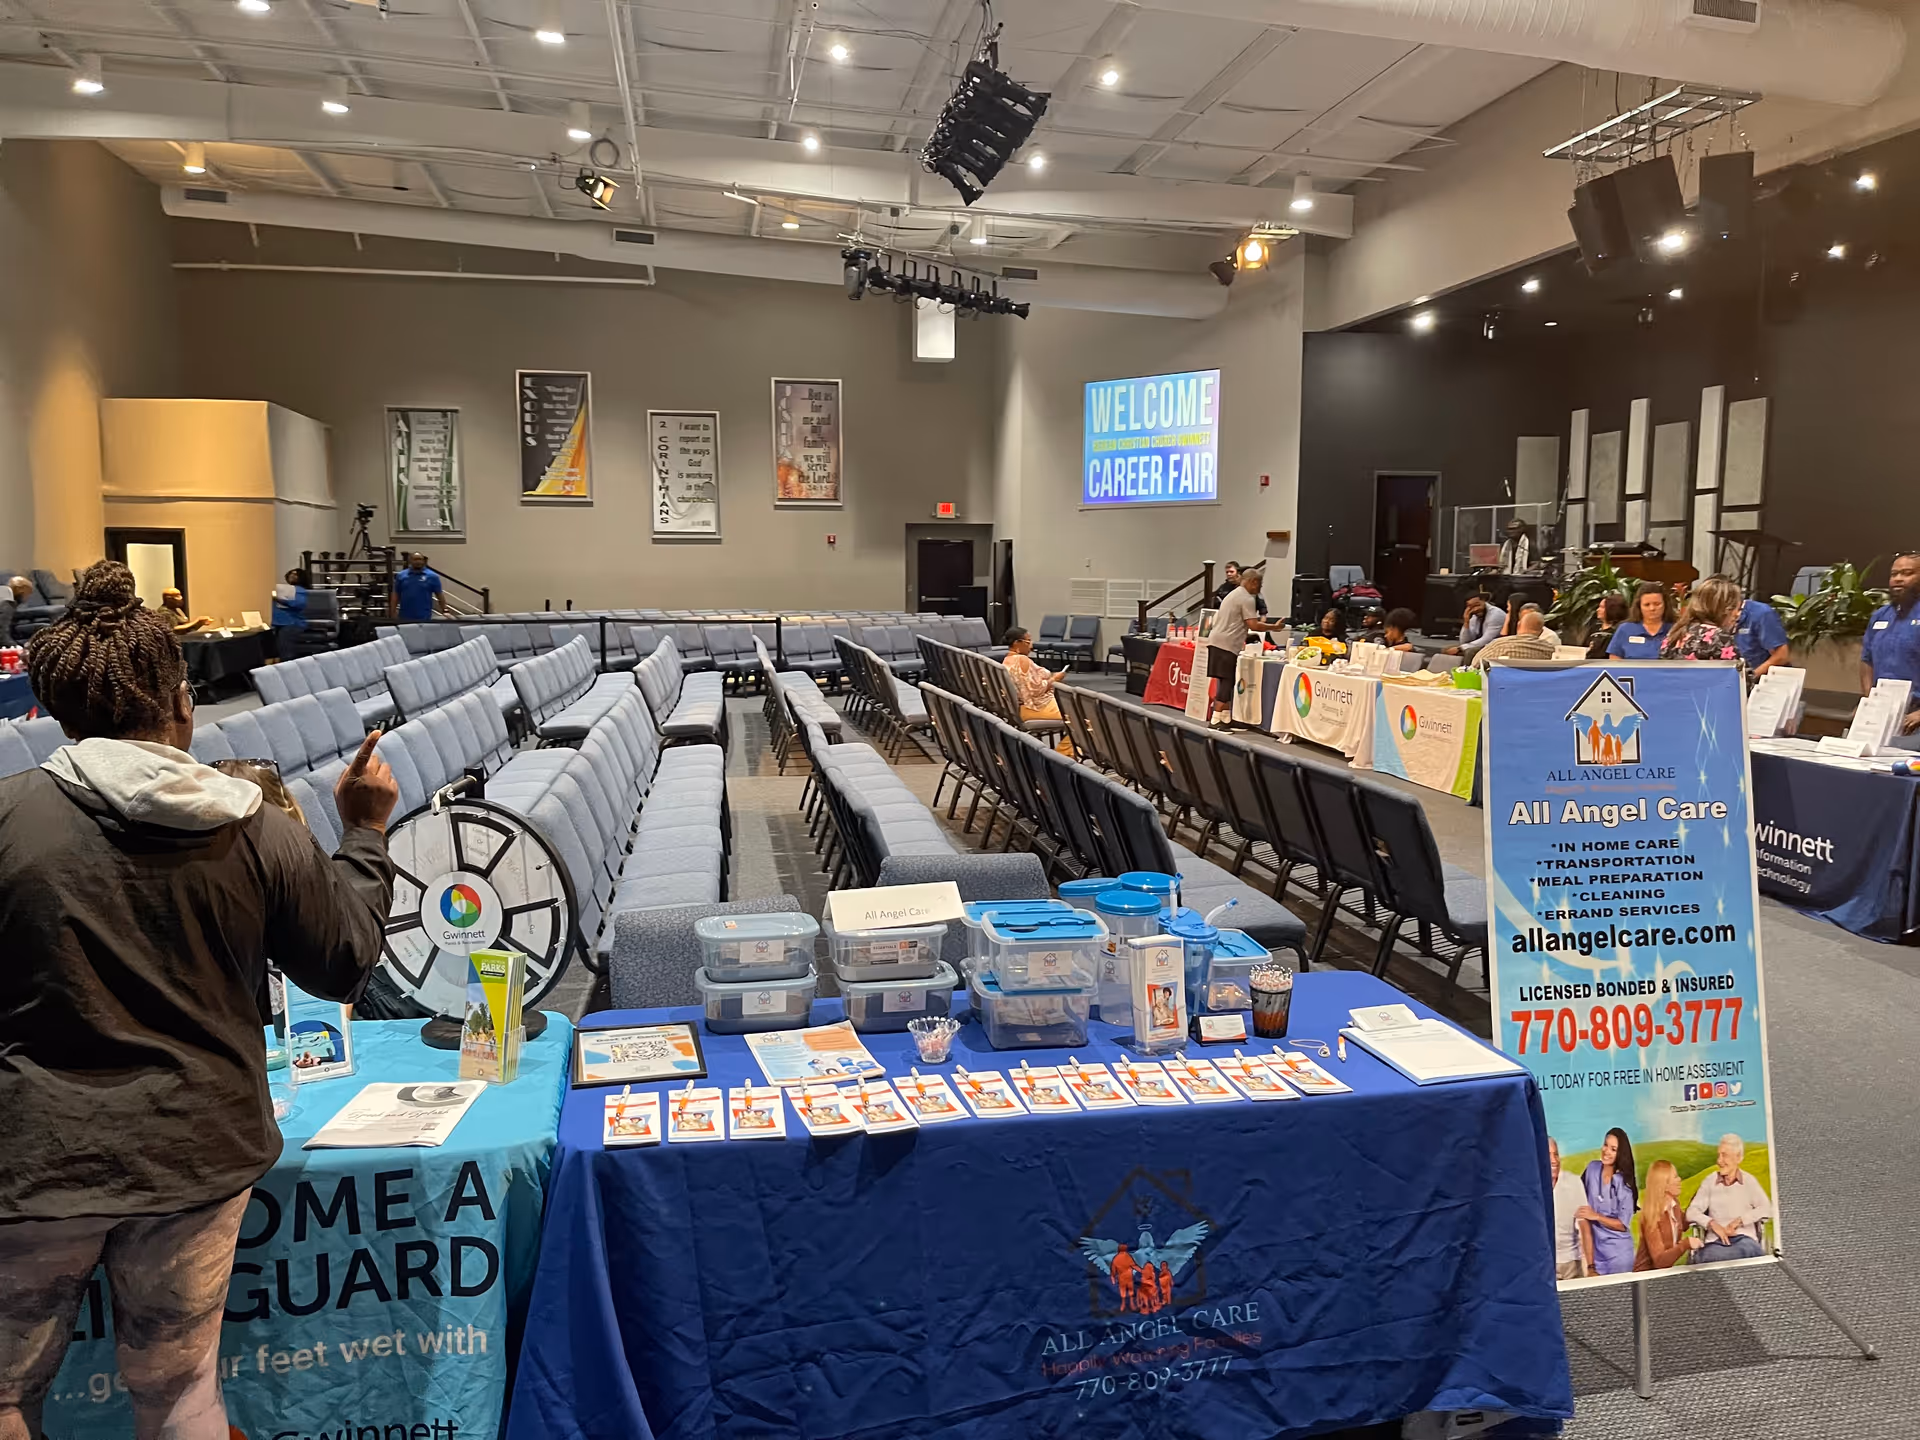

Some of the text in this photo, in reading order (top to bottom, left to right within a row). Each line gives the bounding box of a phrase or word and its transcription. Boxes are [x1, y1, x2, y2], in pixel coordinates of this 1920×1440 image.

[1091, 376, 1214, 433] WELCOME
[688, 458, 702, 468] God
[692, 448, 711, 457] ways
[657, 436, 670, 524] CORINTHIANS
[807, 463, 828, 472] serve
[1088, 452, 1214, 498] CAREER FAIR
[1314, 681, 1353, 706] Gwinnett
[1418, 715, 1453, 735] Gwinnett
[1546, 766, 1676, 783] ALL ANGEL CARE
[1508, 796, 1728, 828] All Angel Care
[1581, 840, 1630, 852] HOME
[1634, 838, 1680, 850] CARE
[1754, 820, 1834, 864] winnett
[1756, 848, 1812, 875] nformation
[1588, 870, 1704, 886] PREPARATION
[1757, 866, 1812, 894] echnology
[864, 907, 931, 920] All Angel Care
[1618, 903, 1701, 918] SERVICES
[442, 930, 486, 940] Gwinnett
[1511, 923, 1736, 956] allangelcare.com
[481, 962, 506, 973] PARKS
[1519, 974, 1735, 1002] LICENSED BONDED & INSURED
[1511, 996, 1743, 1056] 770-809-3777
[1536, 1060, 1745, 1092] LL TODAY FOR FREE IN HOME ASSESMENT
[236, 1160, 496, 1250] OME A
[222, 1235, 500, 1323] GUARD
[1041, 1301, 1261, 1356] ALL ANGEL CARE
[1193, 1330, 1262, 1352] Failies
[53, 1322, 489, 1404] ...ge ur feet wet with
[1074, 1355, 1233, 1401] 770-809-3777
